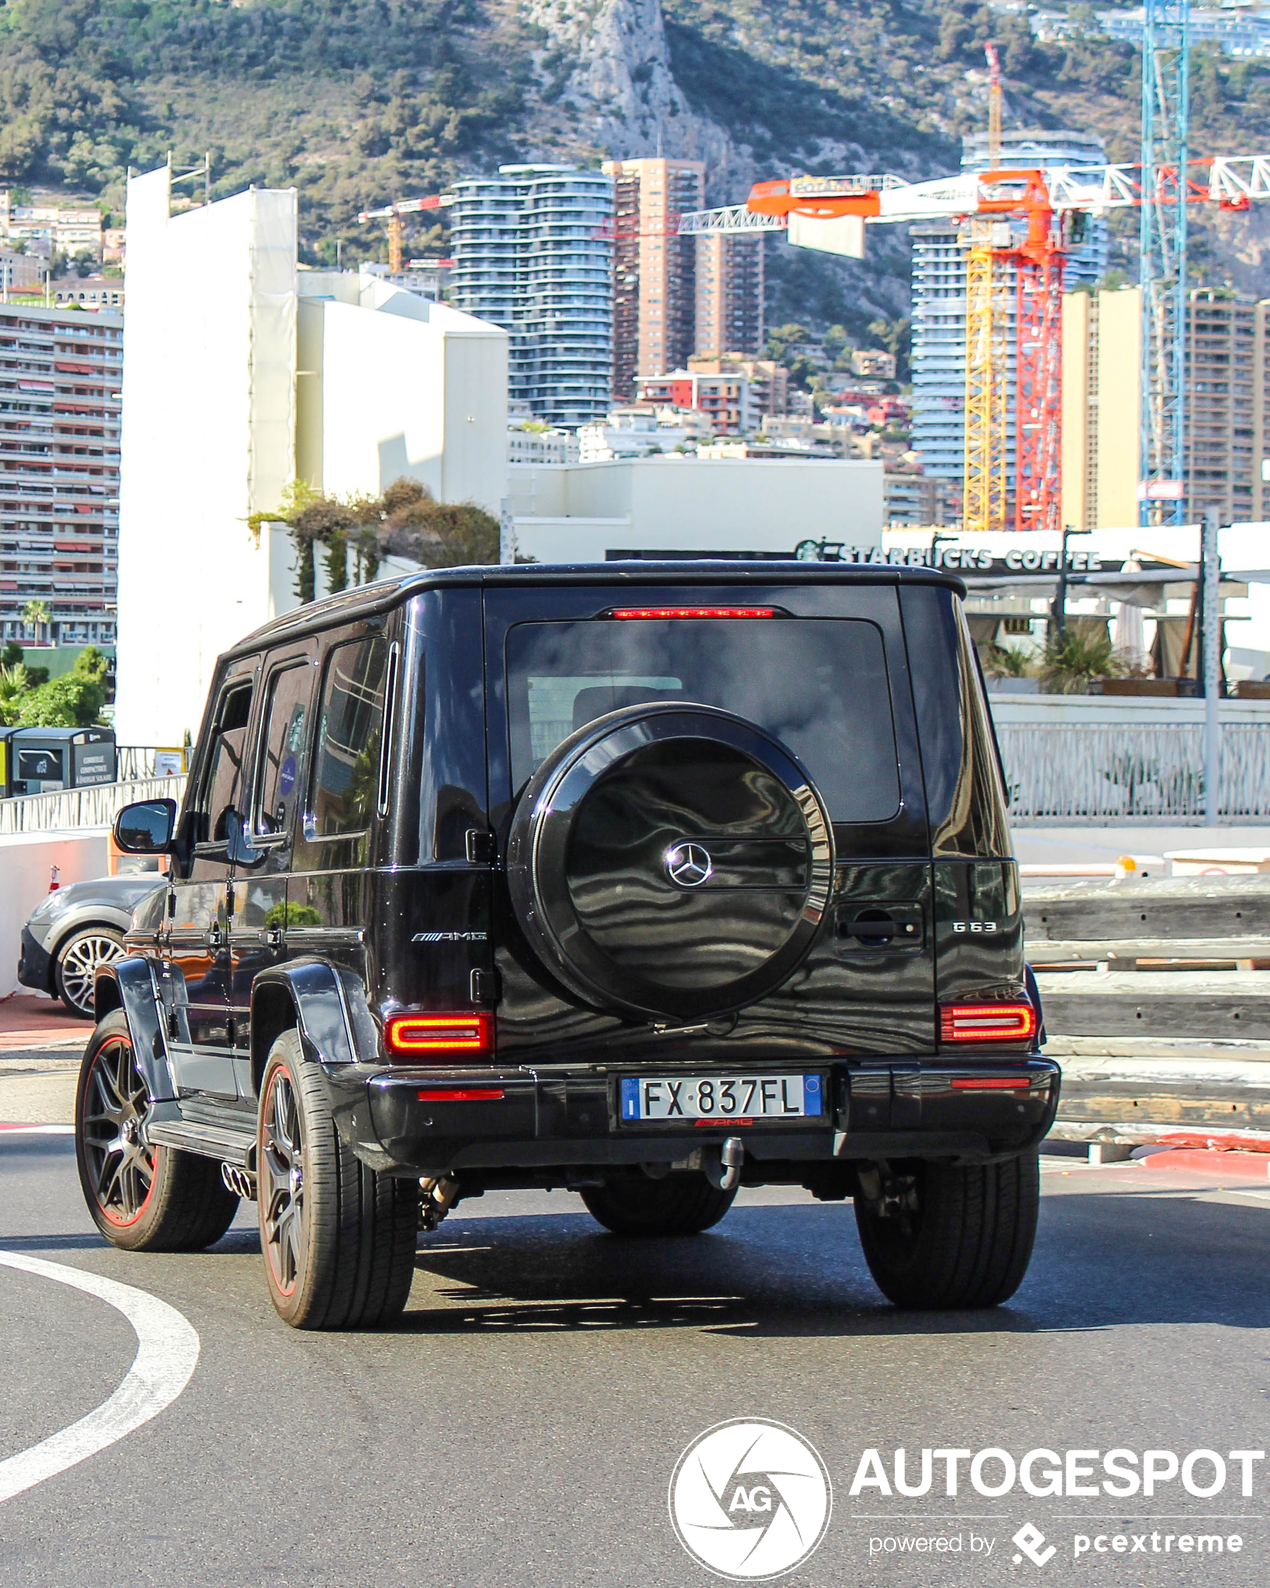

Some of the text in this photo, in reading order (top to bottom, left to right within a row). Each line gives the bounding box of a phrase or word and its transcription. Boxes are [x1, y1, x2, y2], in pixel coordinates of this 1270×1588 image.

[838, 546, 1103, 570] STARBUCKS COFFEE
[438, 932, 487, 941] AMG
[642, 1078, 800, 1116] FX 837FL
[712, 1118, 754, 1127] AMG
